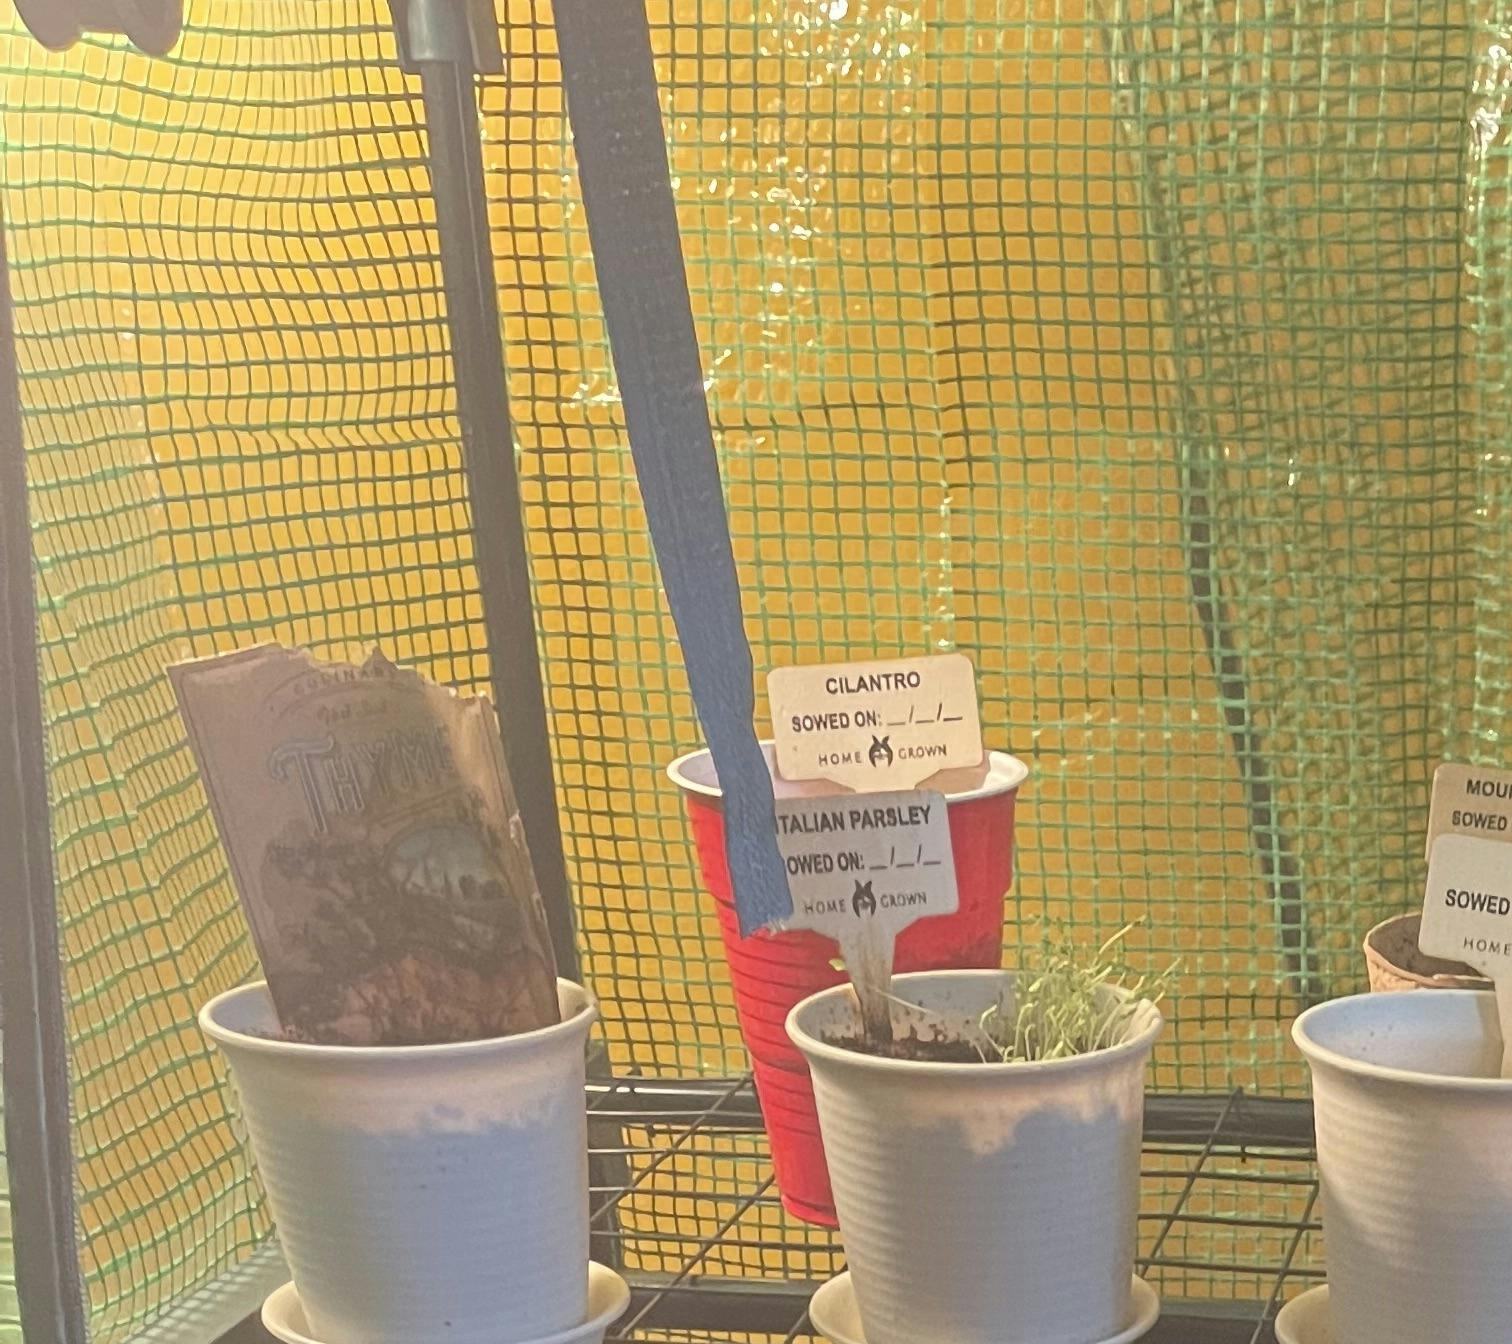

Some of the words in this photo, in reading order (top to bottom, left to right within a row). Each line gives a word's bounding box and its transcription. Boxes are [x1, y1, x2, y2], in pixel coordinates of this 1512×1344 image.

[825, 671, 921, 695] CILANTRO
[791, 711, 850, 733] SOWED
[853, 710, 882, 729] ON:
[818, 750, 863, 766] HOME
[898, 744, 947, 760] GROWN
[267, 722, 456, 836] THYME
[849, 804, 931, 830] PARSLEY
[1451, 810, 1508, 832] SOWED
[785, 853, 834, 875] OWED
[837, 854, 866, 872] ON:
[804, 899, 847, 915] HOME
[880, 891, 928, 908] GROWN
[1444, 888, 1511, 916] SOWED
[1463, 937, 1512, 956] HOME
